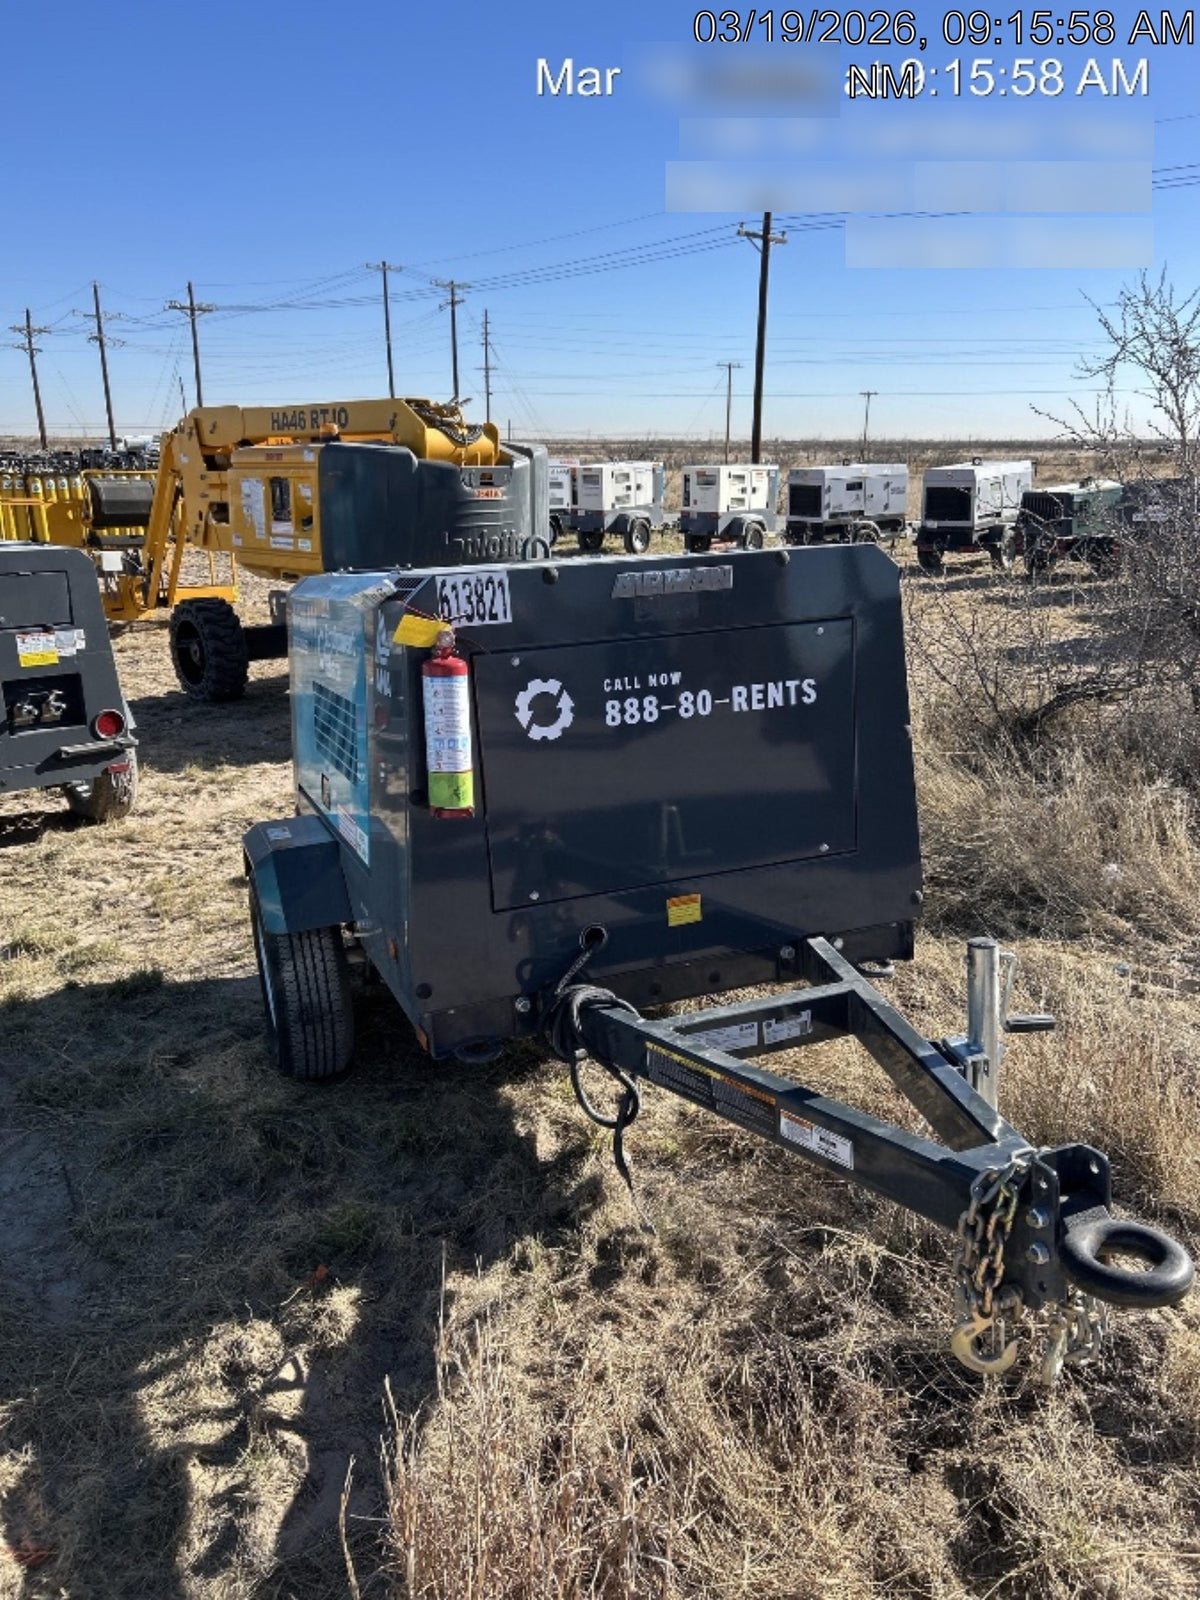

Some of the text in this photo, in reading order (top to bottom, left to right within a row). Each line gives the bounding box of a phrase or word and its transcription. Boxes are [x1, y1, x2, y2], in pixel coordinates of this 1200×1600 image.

[271, 411, 306, 431] HA46
[438, 574, 508, 623] 613821
[603, 672, 682, 692] CALL NOW
[605, 678, 817, 727] 888-80-RENTS
